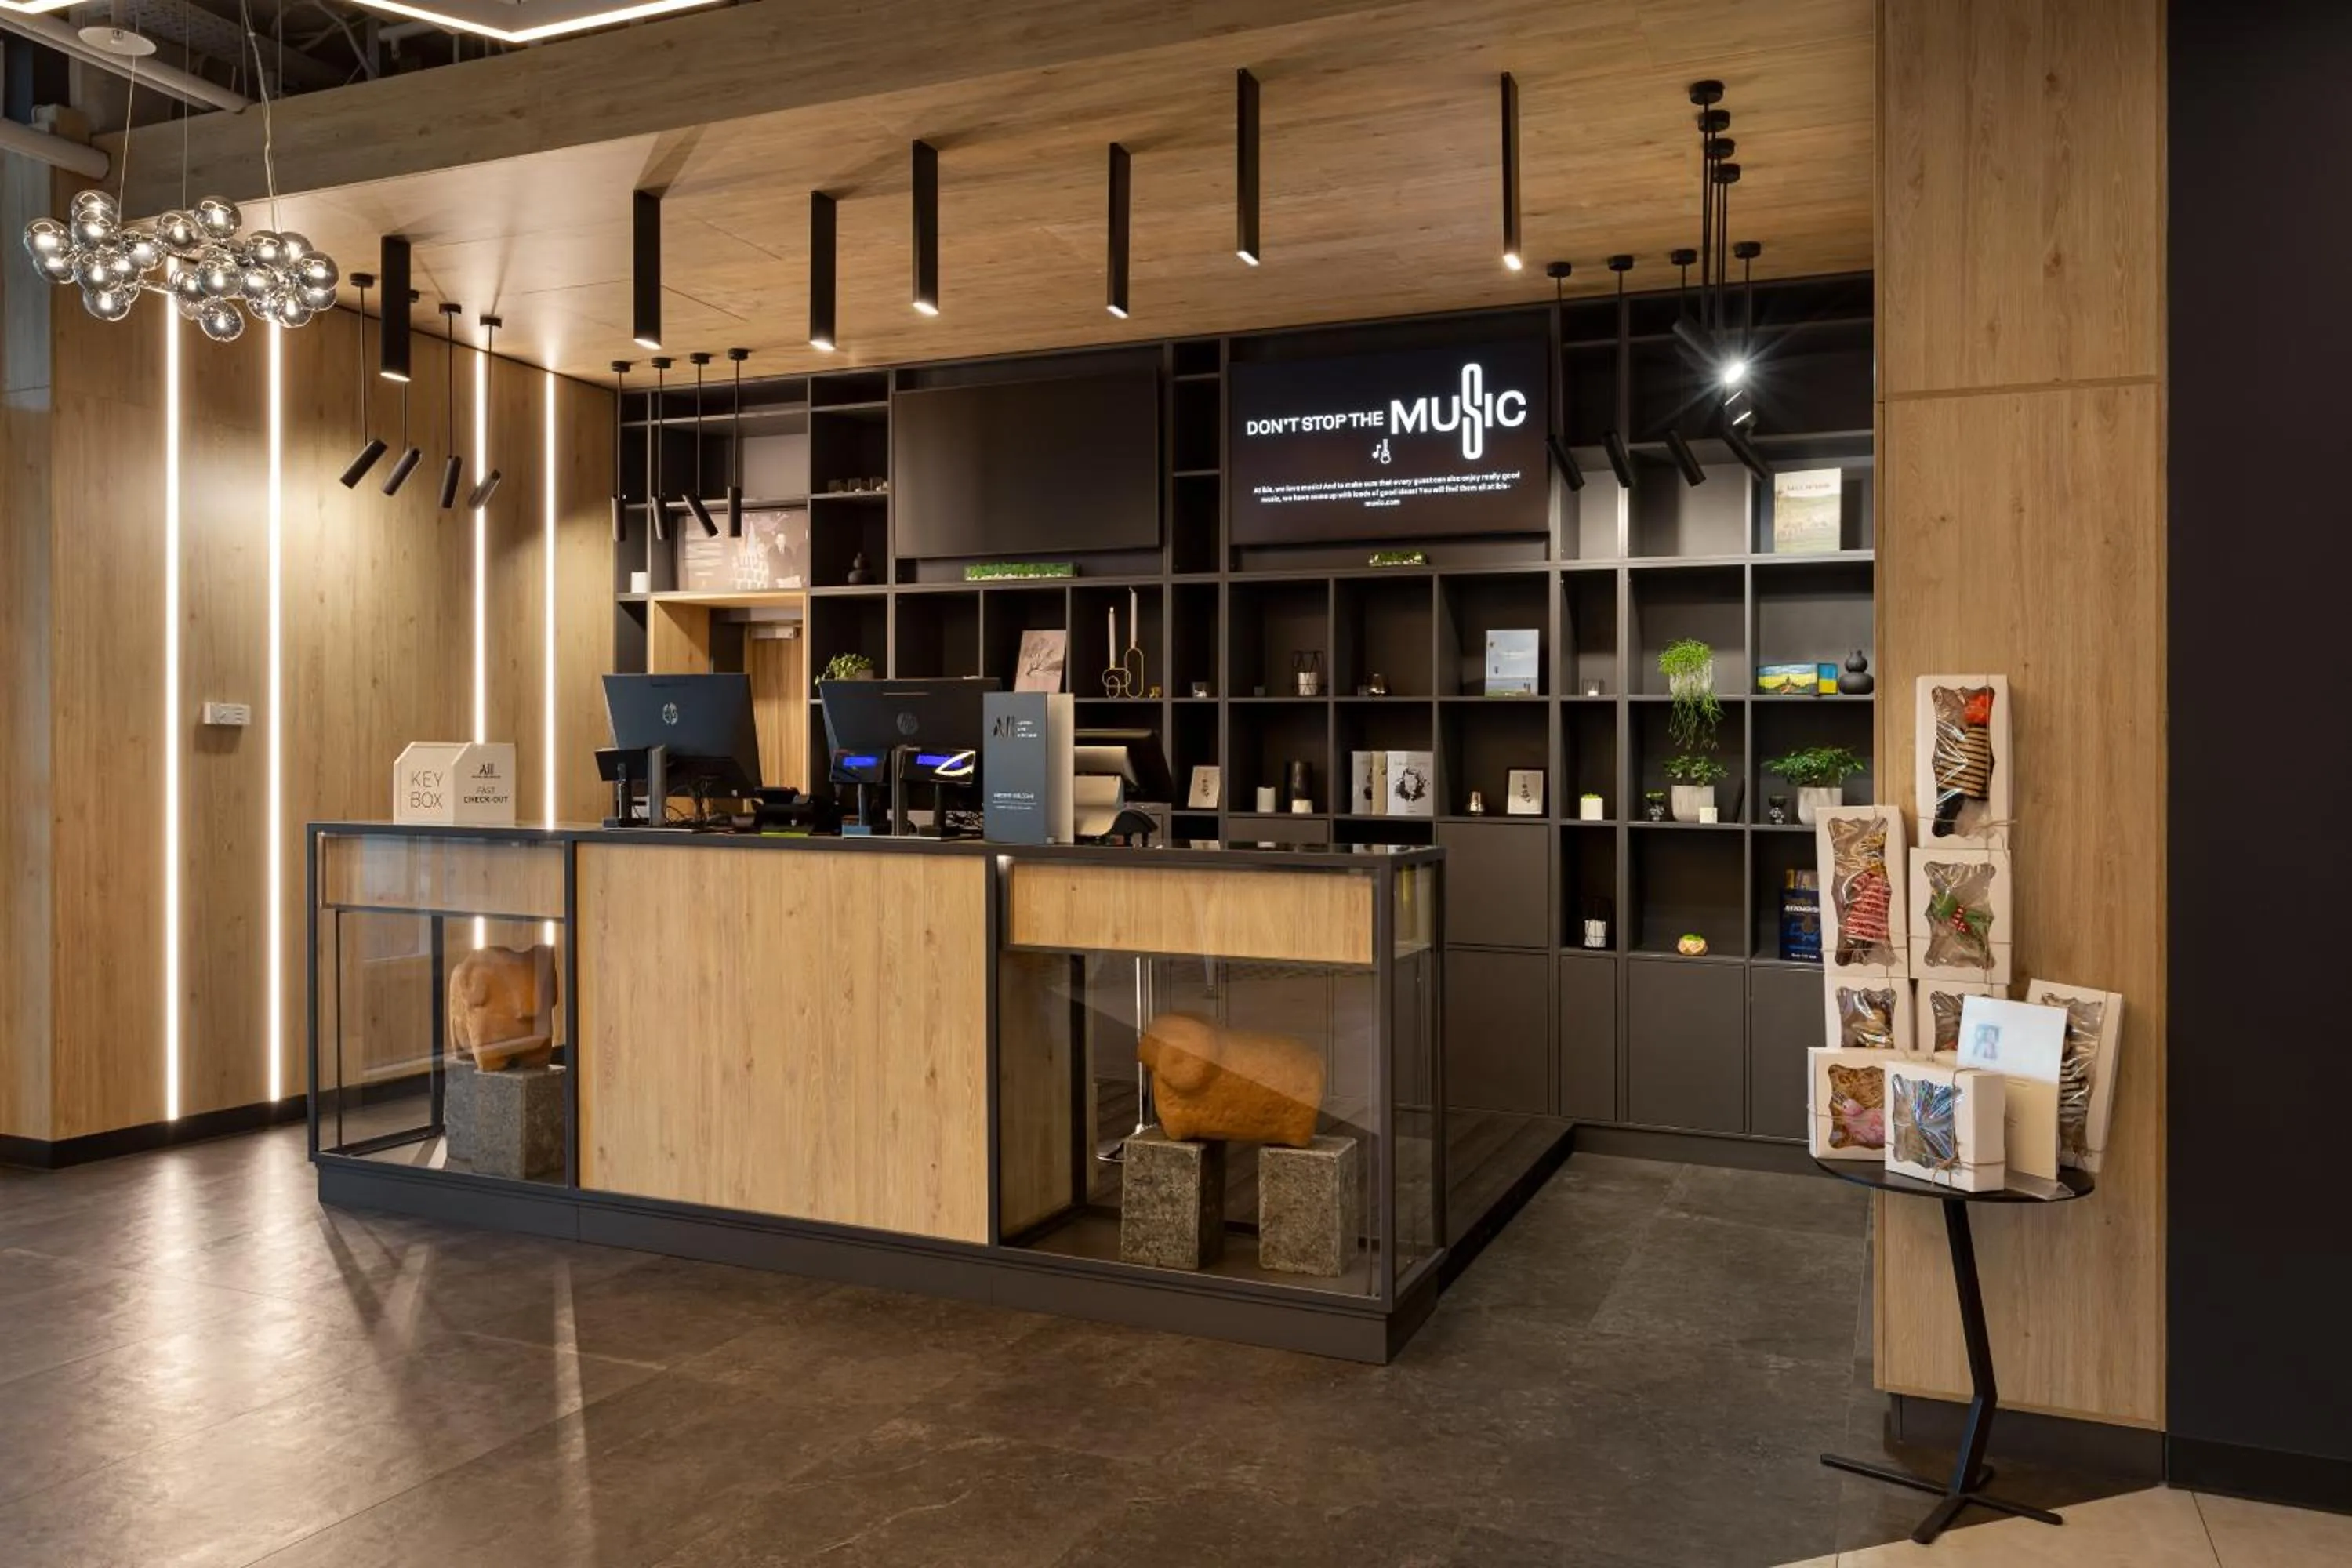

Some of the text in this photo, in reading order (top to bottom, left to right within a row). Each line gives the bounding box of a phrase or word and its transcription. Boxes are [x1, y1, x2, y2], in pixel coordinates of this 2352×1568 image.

[1247, 363, 1526, 460] DON'T STOP THE MUSIC
[1323, 481, 1337, 490] And
[1345, 480, 1363, 488] make
[1414, 477, 1433, 486] guest
[1461, 474, 1481, 483] enjoy
[1481, 472, 1501, 481] really
[1501, 470, 1521, 481] good
[1293, 493, 1310, 502] have
[1352, 489, 1371, 498] loads
[1379, 488, 1398, 498] good
[1432, 485, 1445, 493] will
[1459, 484, 1478, 492] them
[411, 771, 444, 788] KEY
[476, 786, 496, 794] FAST
[410, 791, 444, 809] BOX
[463, 796, 509, 804] CHECK-OUT
